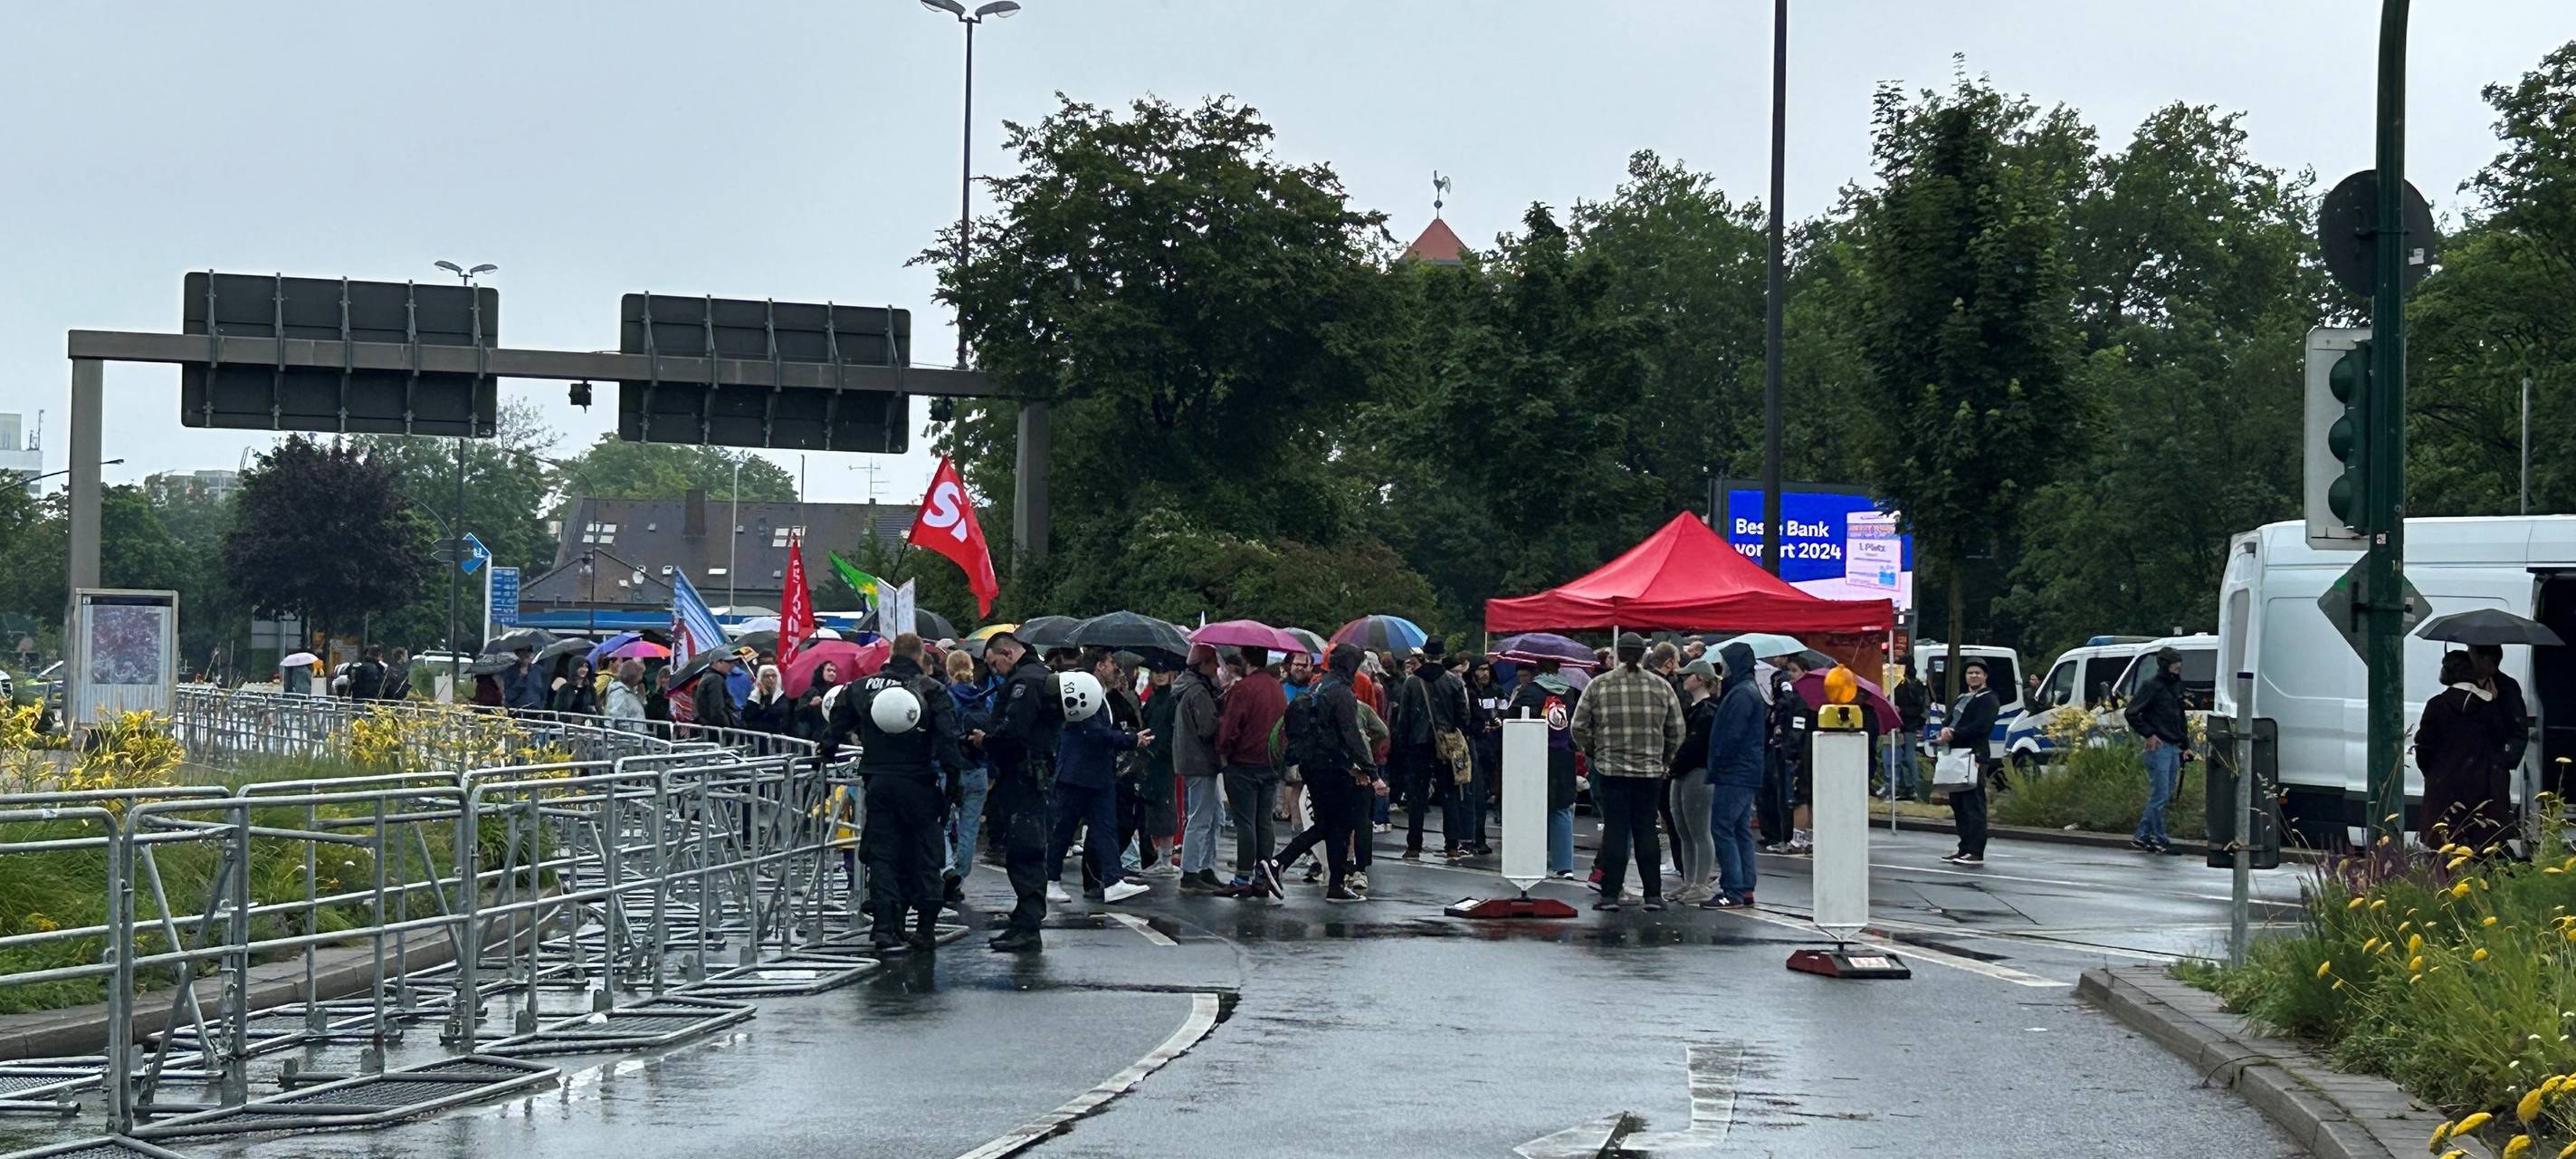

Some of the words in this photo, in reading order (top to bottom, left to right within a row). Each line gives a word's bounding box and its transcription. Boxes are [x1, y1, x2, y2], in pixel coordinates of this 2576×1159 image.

[1735, 518, 1783, 535] Bes
[1787, 520, 1829, 537] Bank
[1798, 542, 1842, 560] 2024
